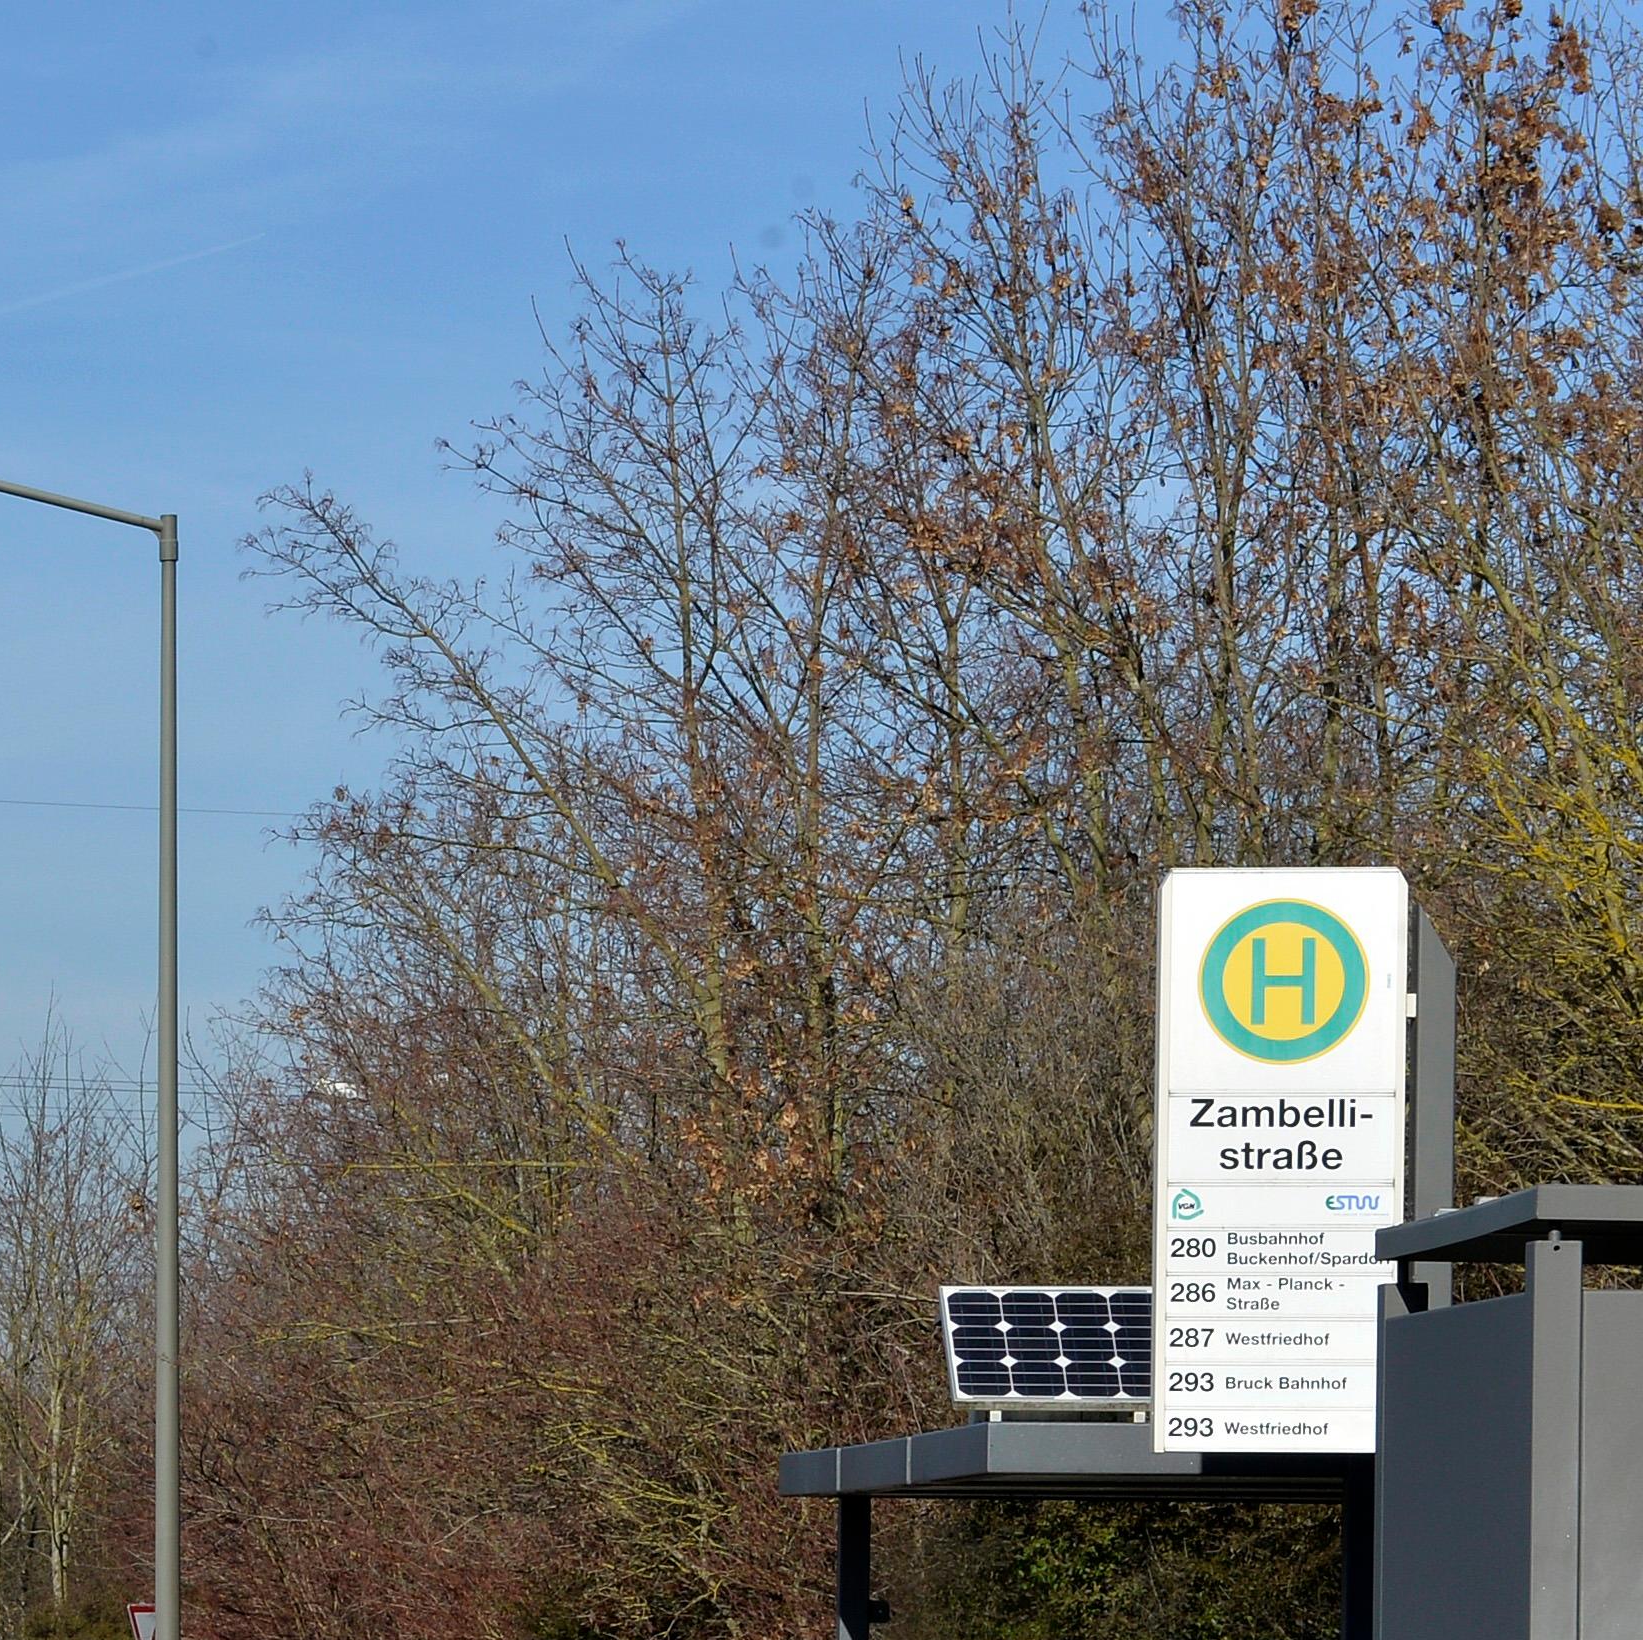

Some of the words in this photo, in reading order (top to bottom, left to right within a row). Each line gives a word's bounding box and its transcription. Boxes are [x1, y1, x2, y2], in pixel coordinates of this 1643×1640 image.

[1189, 1098, 1374, 1128] Zambelli-
[1219, 1140, 1344, 1171] straße
[1170, 1237, 1217, 1258] 280
[1226, 1232, 1325, 1246] Busbahnhof
[1170, 1282, 1216, 1303] 286
[1226, 1277, 1261, 1291] Max
[1278, 1277, 1334, 1291] Planck
[1226, 1297, 1281, 1311] Straße
[1169, 1328, 1215, 1348] 287
[1225, 1332, 1331, 1346] Westfriedhof
[1168, 1372, 1215, 1392] 293
[1225, 1376, 1274, 1390] Bruck
[1278, 1376, 1348, 1390] Bahnhof
[1168, 1417, 1214, 1437] 293
[1224, 1421, 1329, 1436] Westfriedhof
